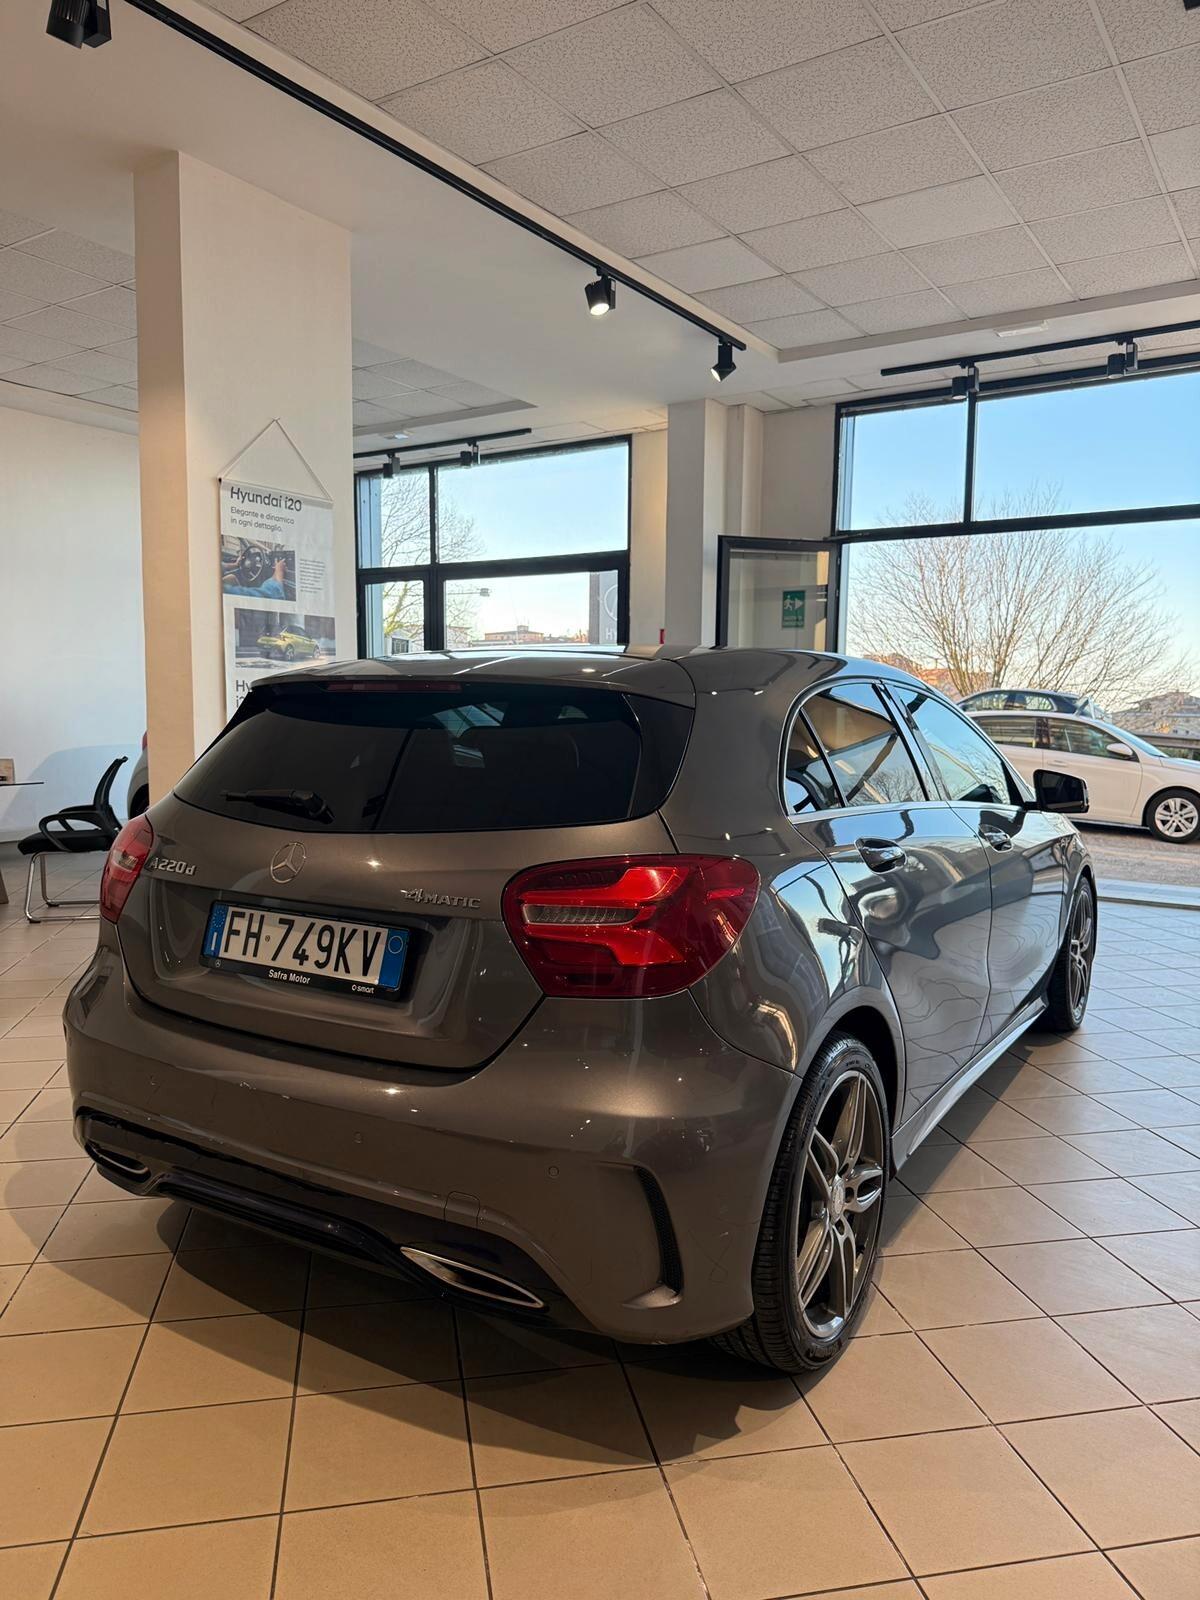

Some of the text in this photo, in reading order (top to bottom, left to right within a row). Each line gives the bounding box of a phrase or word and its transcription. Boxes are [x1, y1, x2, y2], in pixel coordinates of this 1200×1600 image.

[230, 486, 302, 512] Hyundai i20
[230, 506, 295, 525] Elegante e dinamico
[230, 517, 238, 525] in
[238, 519, 253, 528] ogni
[149, 857, 197, 876] A220d
[400, 888, 481, 908] 4MATIC
[268, 969, 311, 985] Safra Motor
[356, 985, 375, 995] smart
